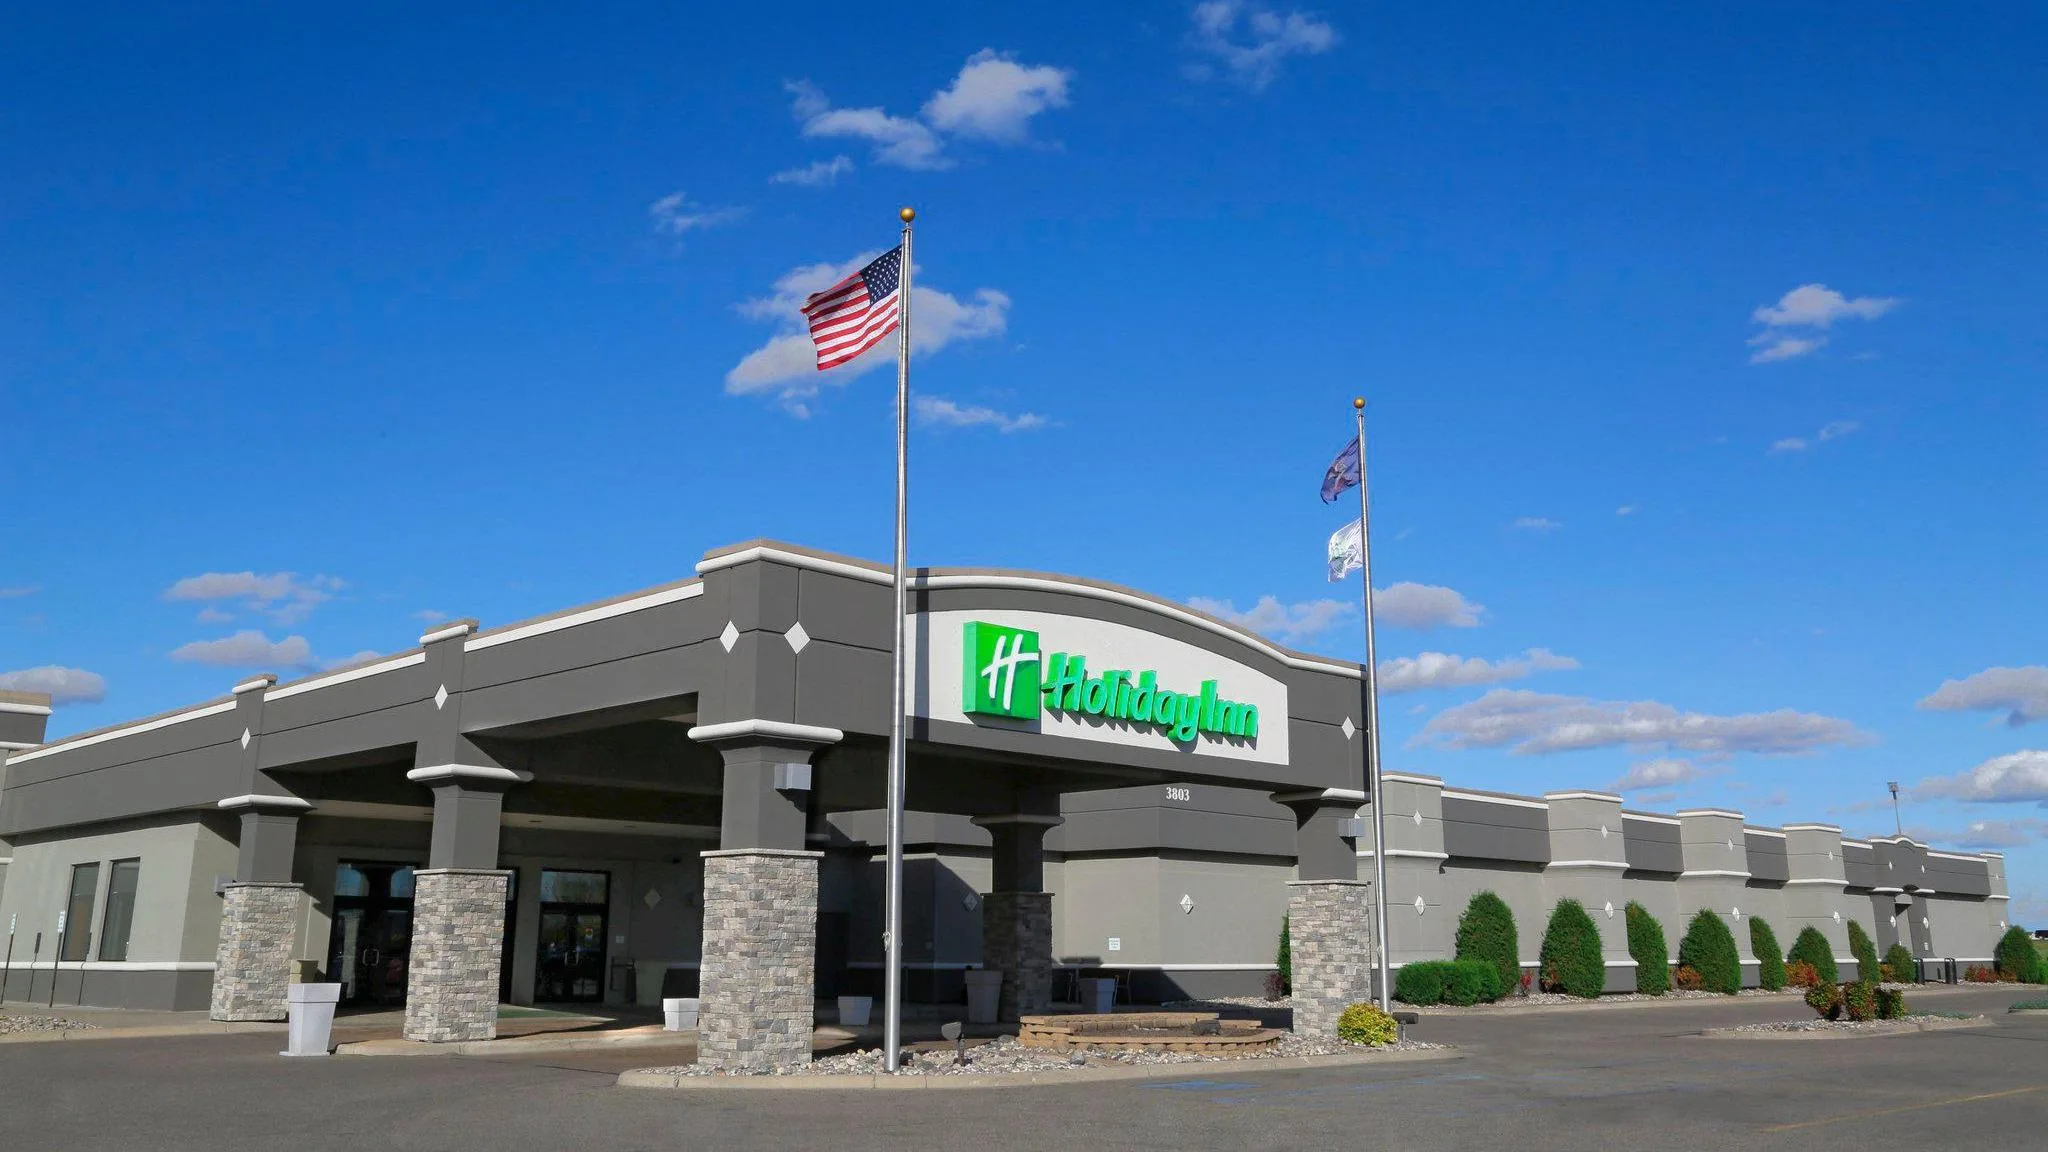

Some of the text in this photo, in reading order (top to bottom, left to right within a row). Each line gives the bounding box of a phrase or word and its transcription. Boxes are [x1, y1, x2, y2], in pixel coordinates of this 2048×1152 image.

[1041, 652, 1259, 742] Holiday Inn
[1165, 786, 1190, 801] 3803
